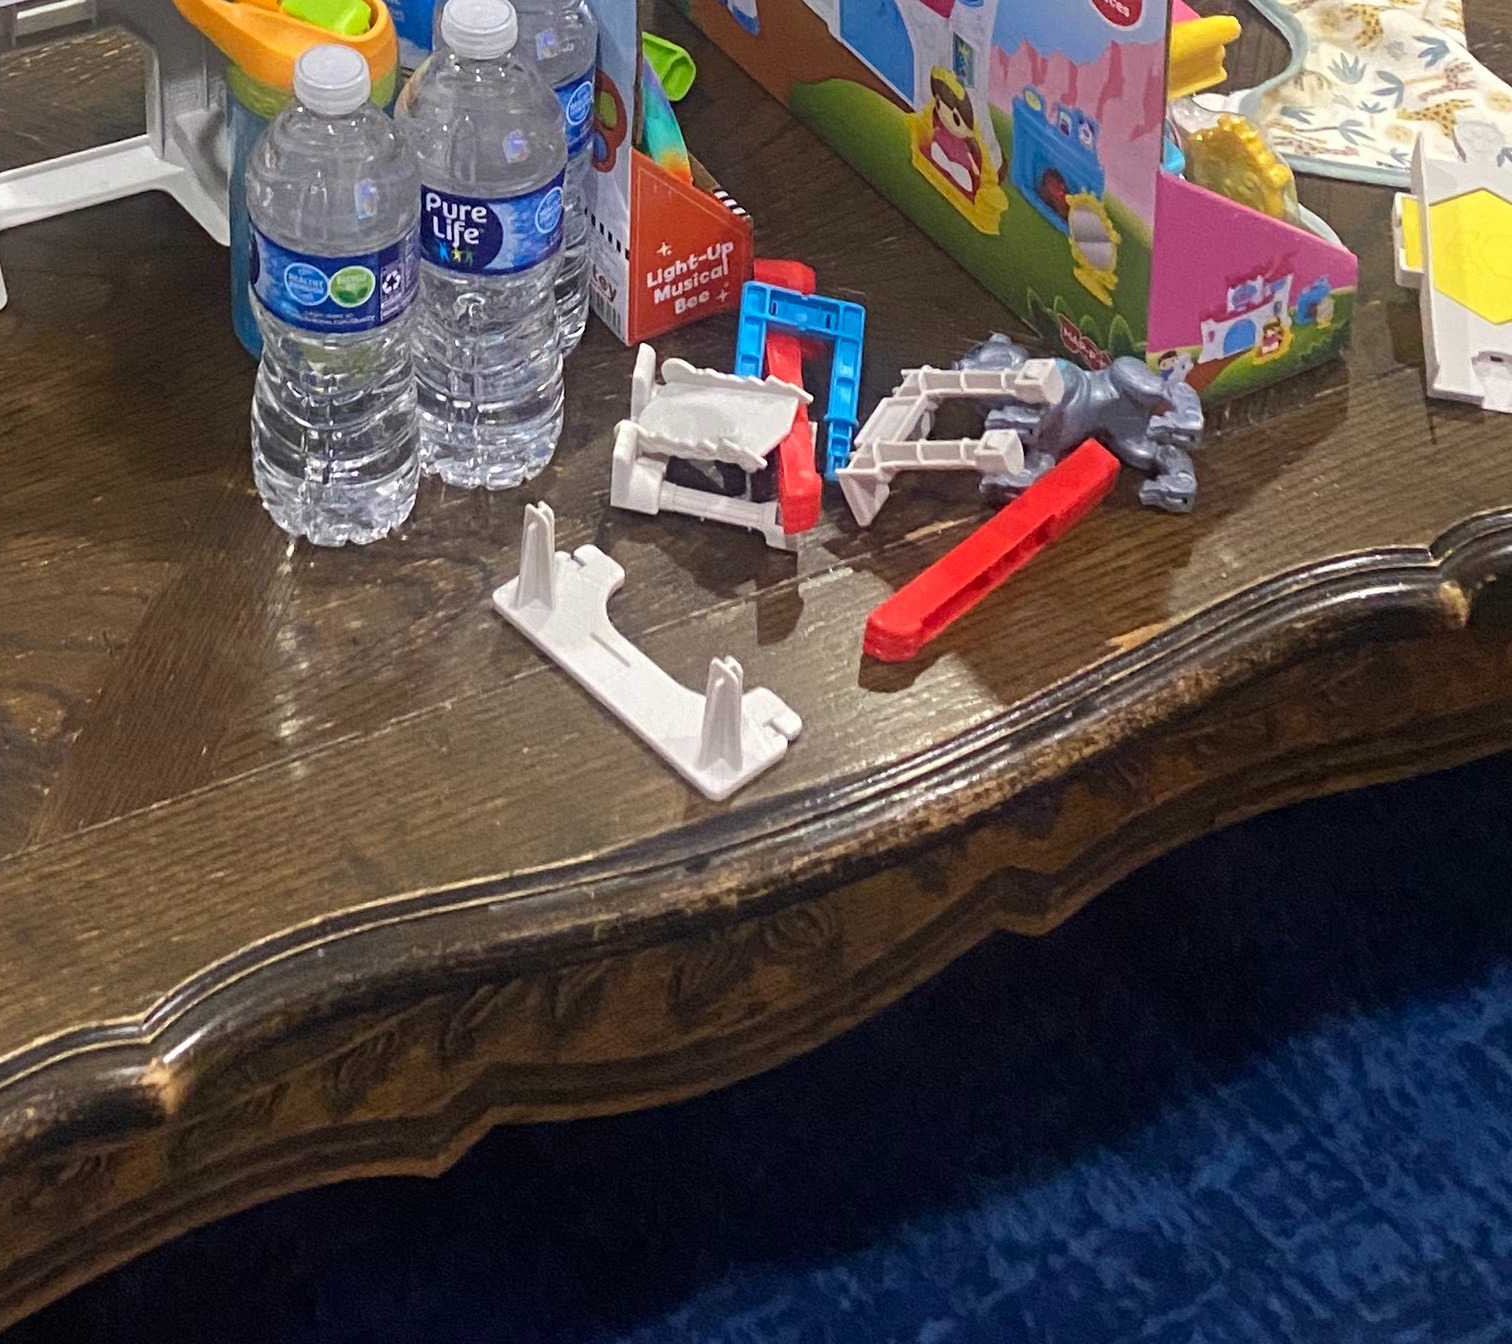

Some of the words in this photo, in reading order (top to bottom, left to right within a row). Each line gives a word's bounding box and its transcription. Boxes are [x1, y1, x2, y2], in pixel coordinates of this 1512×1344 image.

[425, 192, 487, 223] Pure
[432, 215, 480, 248] Life
[646, 241, 734, 288] Light-Up
[653, 262, 728, 304] Musical
[674, 290, 710, 315] Bee
